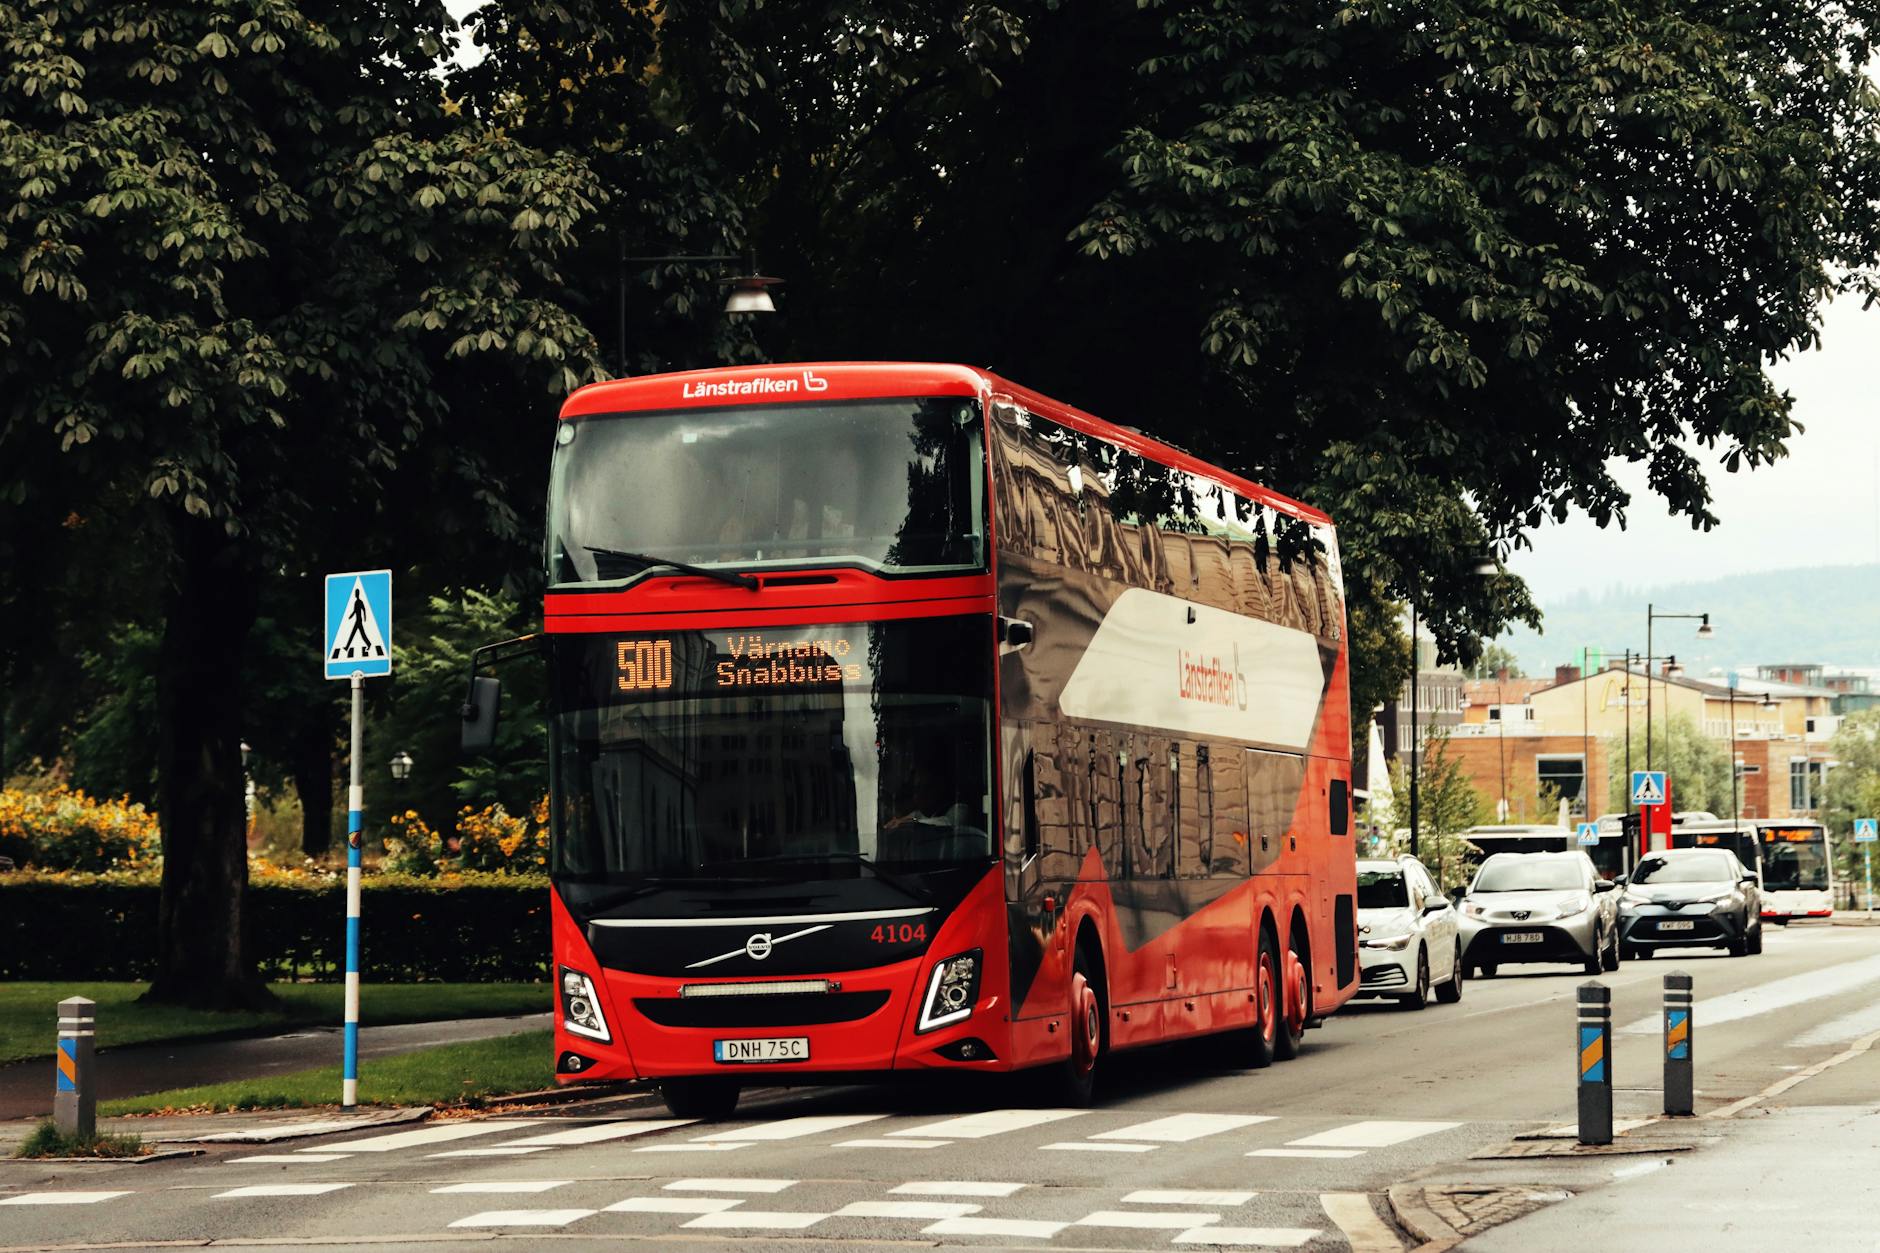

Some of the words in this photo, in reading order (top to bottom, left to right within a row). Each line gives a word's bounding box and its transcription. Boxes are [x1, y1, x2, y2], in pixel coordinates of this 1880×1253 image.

[683, 378, 798, 398] Länstrafiken
[727, 635, 851, 660] Värnamo
[618, 639, 672, 690] 500
[717, 659, 862, 686] Snabbuss
[1178, 648, 1234, 707] Länstrafiken
[871, 923, 927, 943] 4104
[729, 1042, 761, 1058] DNH
[768, 1040, 801, 1056] 75C
